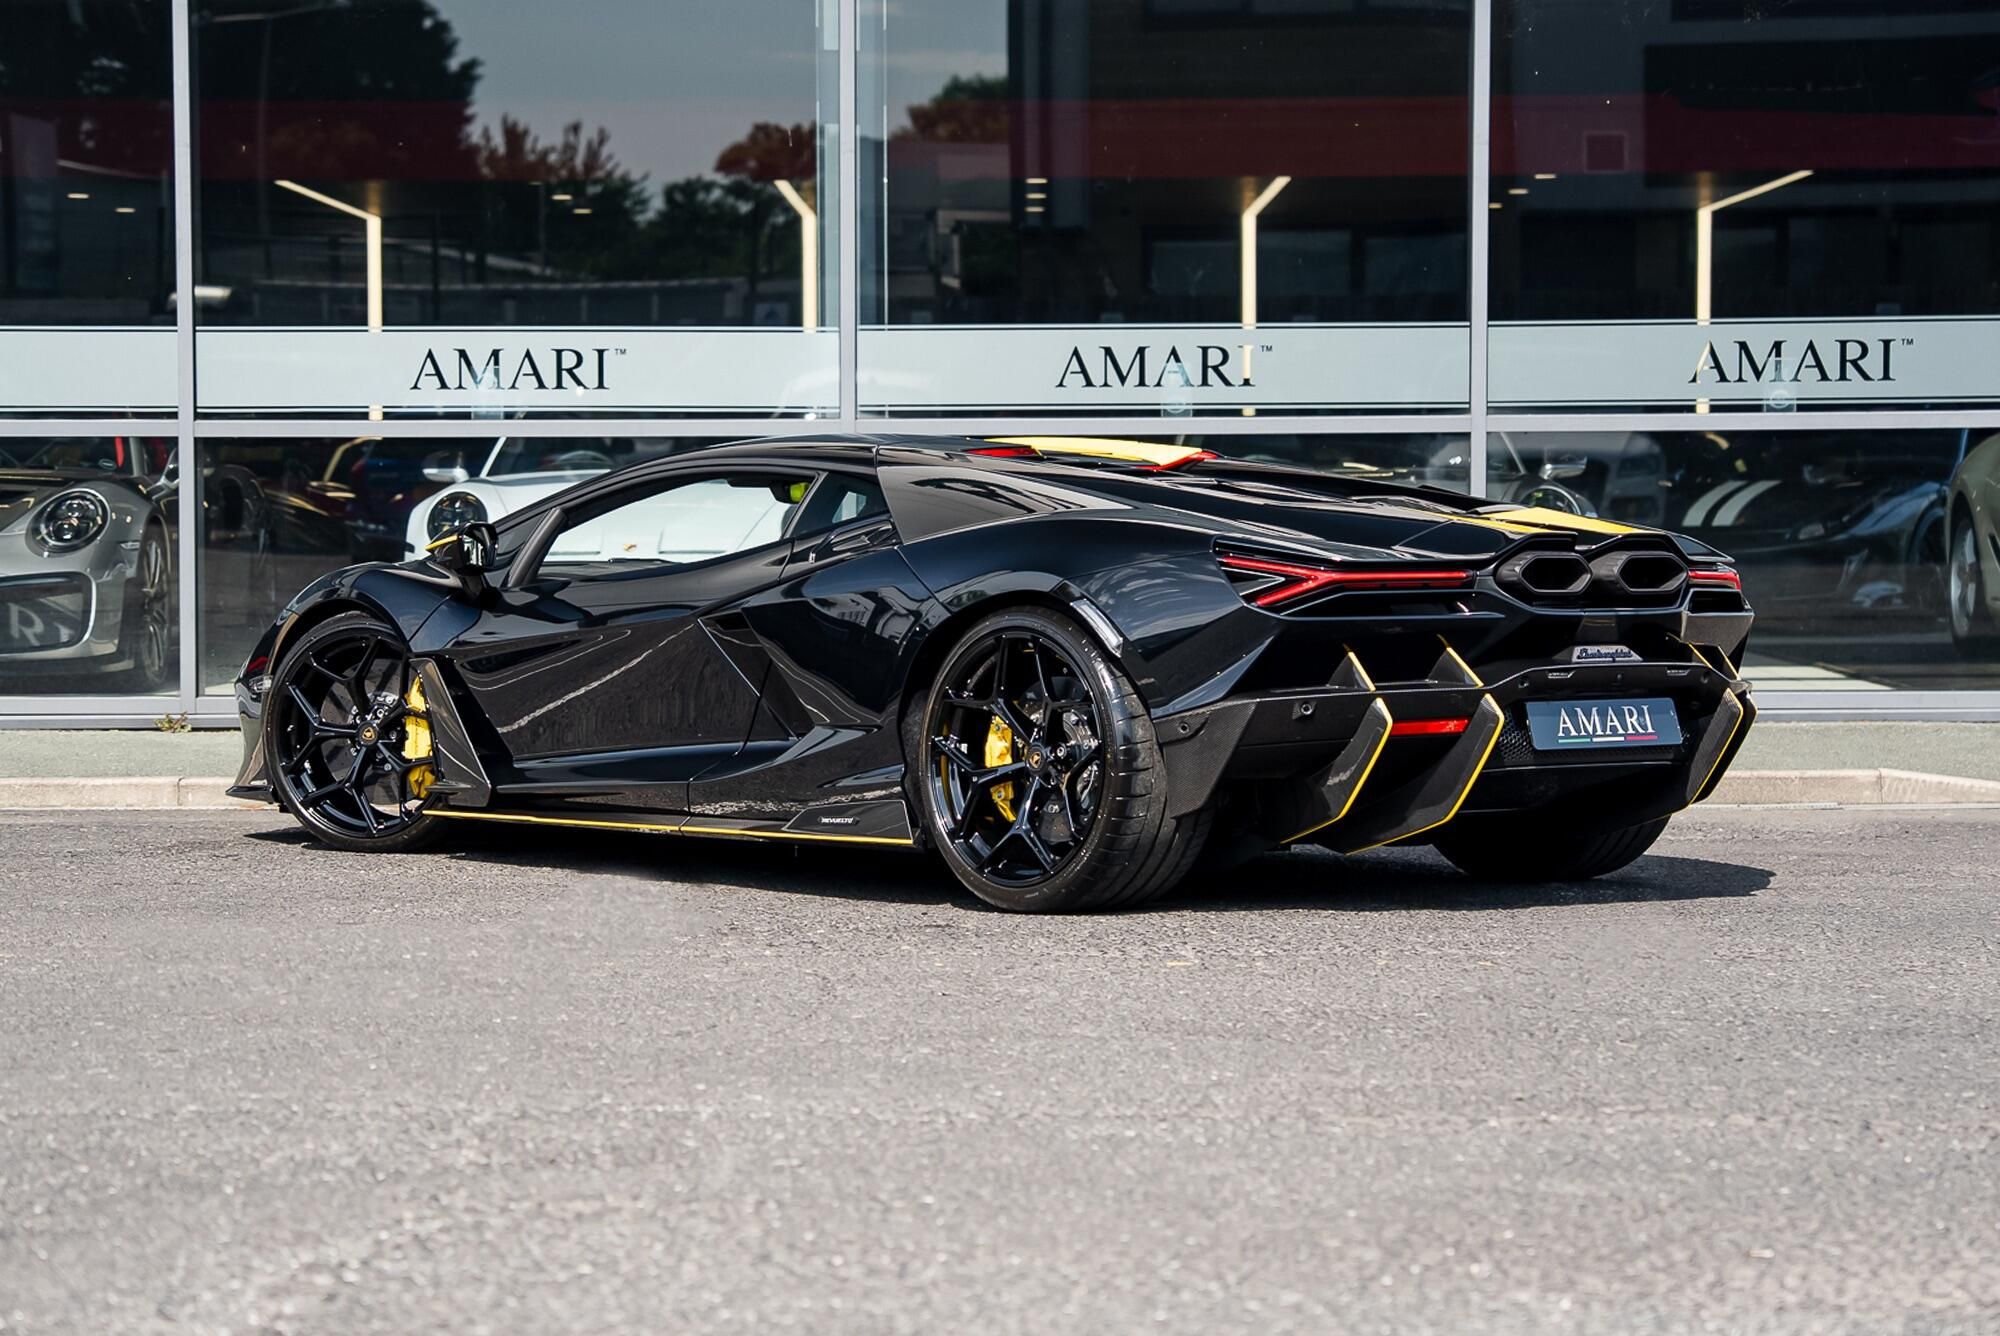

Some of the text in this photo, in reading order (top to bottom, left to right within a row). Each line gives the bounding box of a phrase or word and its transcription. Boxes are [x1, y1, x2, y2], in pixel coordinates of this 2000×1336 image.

[409, 347, 610, 391] AMARI
[1055, 344, 1256, 388] AMARI
[1688, 338, 1897, 384] AMARI
[1557, 704, 1656, 737] AMARI
